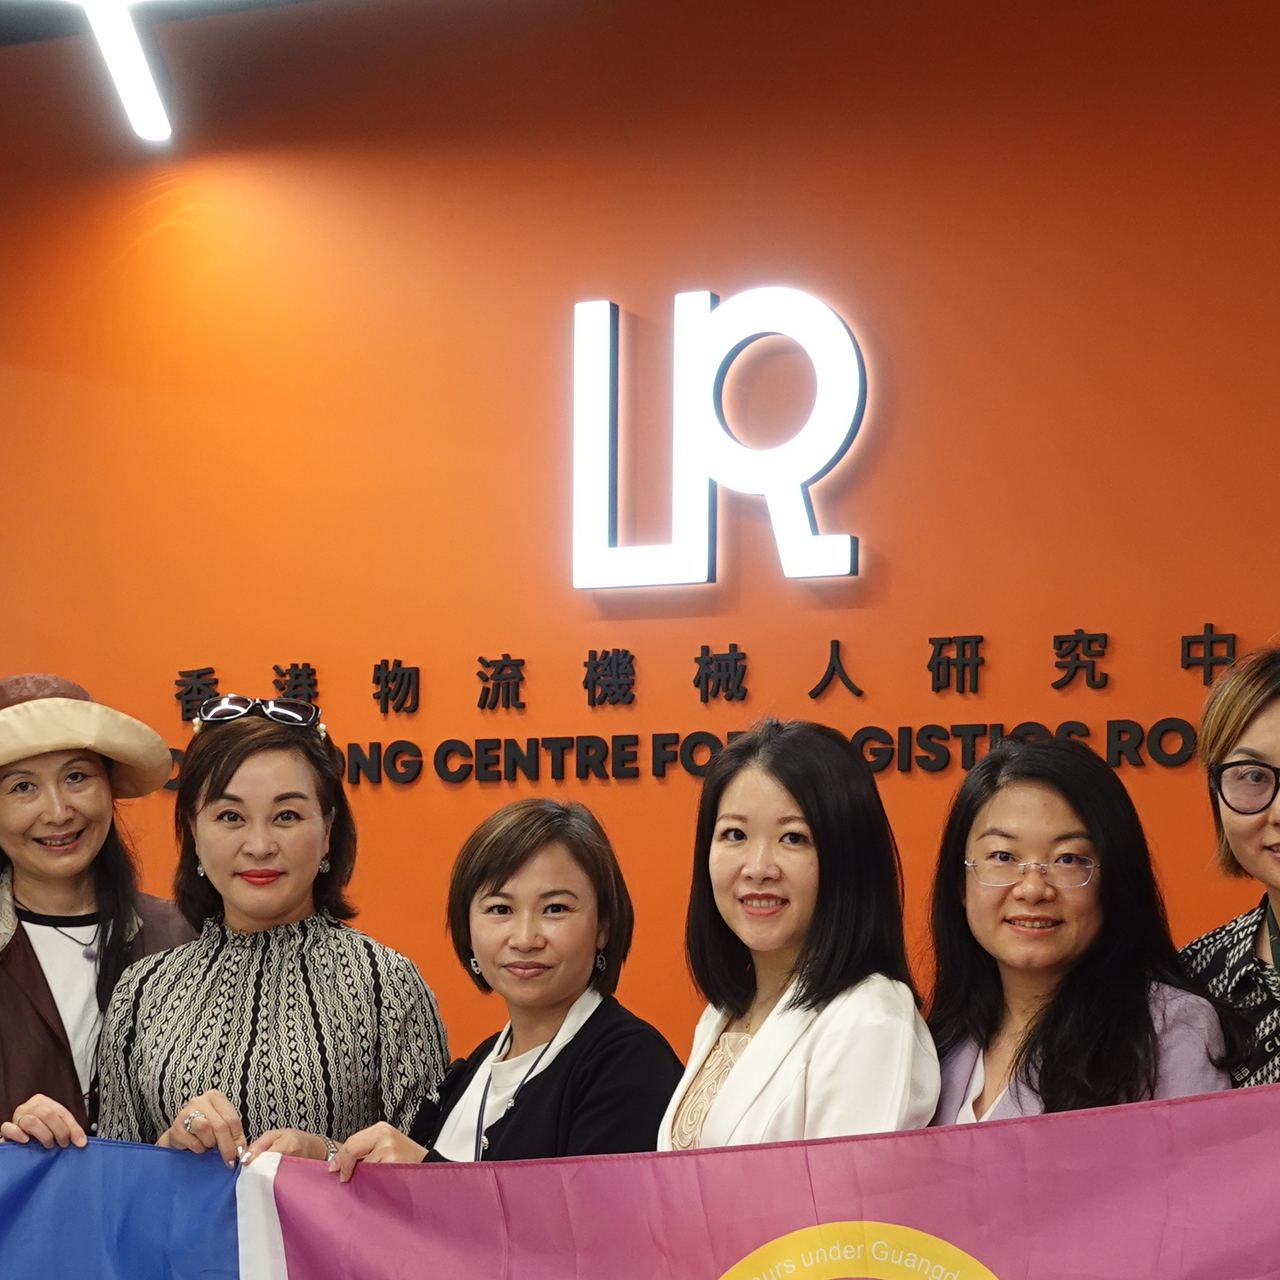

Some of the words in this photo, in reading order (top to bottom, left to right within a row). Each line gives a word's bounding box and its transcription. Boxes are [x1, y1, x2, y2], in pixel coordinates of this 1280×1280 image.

[433, 733, 640, 784] CENTRE
[651, 730, 746, 778] FO
[801, 1240, 865, 1267] under
